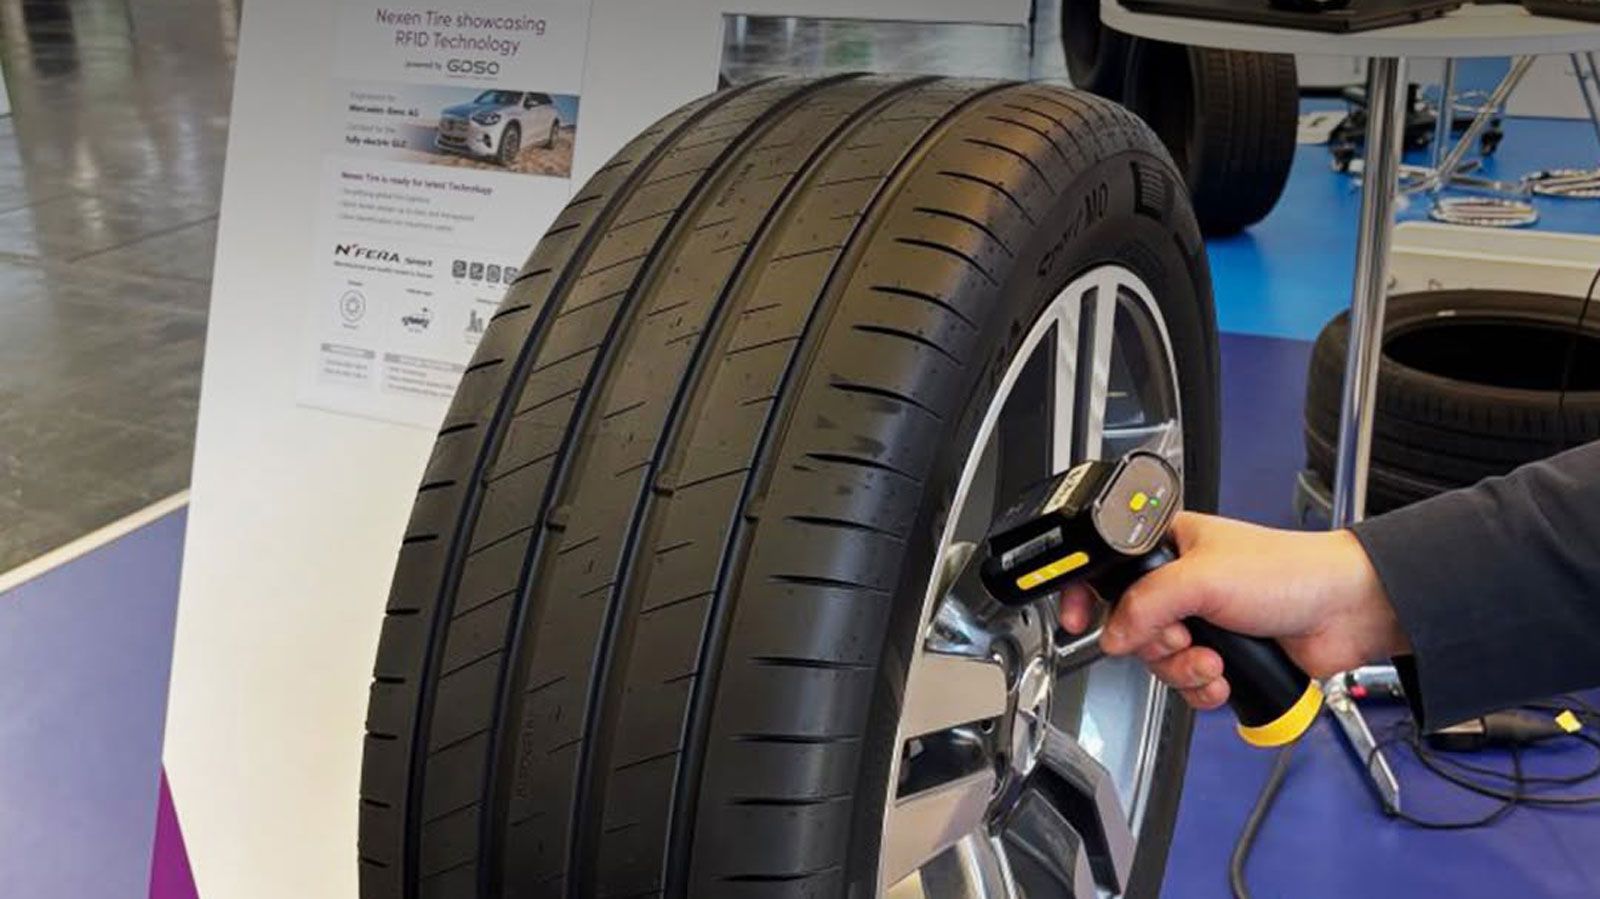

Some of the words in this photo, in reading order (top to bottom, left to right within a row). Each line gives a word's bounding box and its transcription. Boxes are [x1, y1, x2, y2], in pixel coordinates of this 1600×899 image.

[376, 8, 422, 25] Nexen
[427, 10, 452, 27] Tire
[457, 12, 547, 36] showcasing
[395, 30, 429, 48] RFID
[432, 32, 520, 56] Technology
